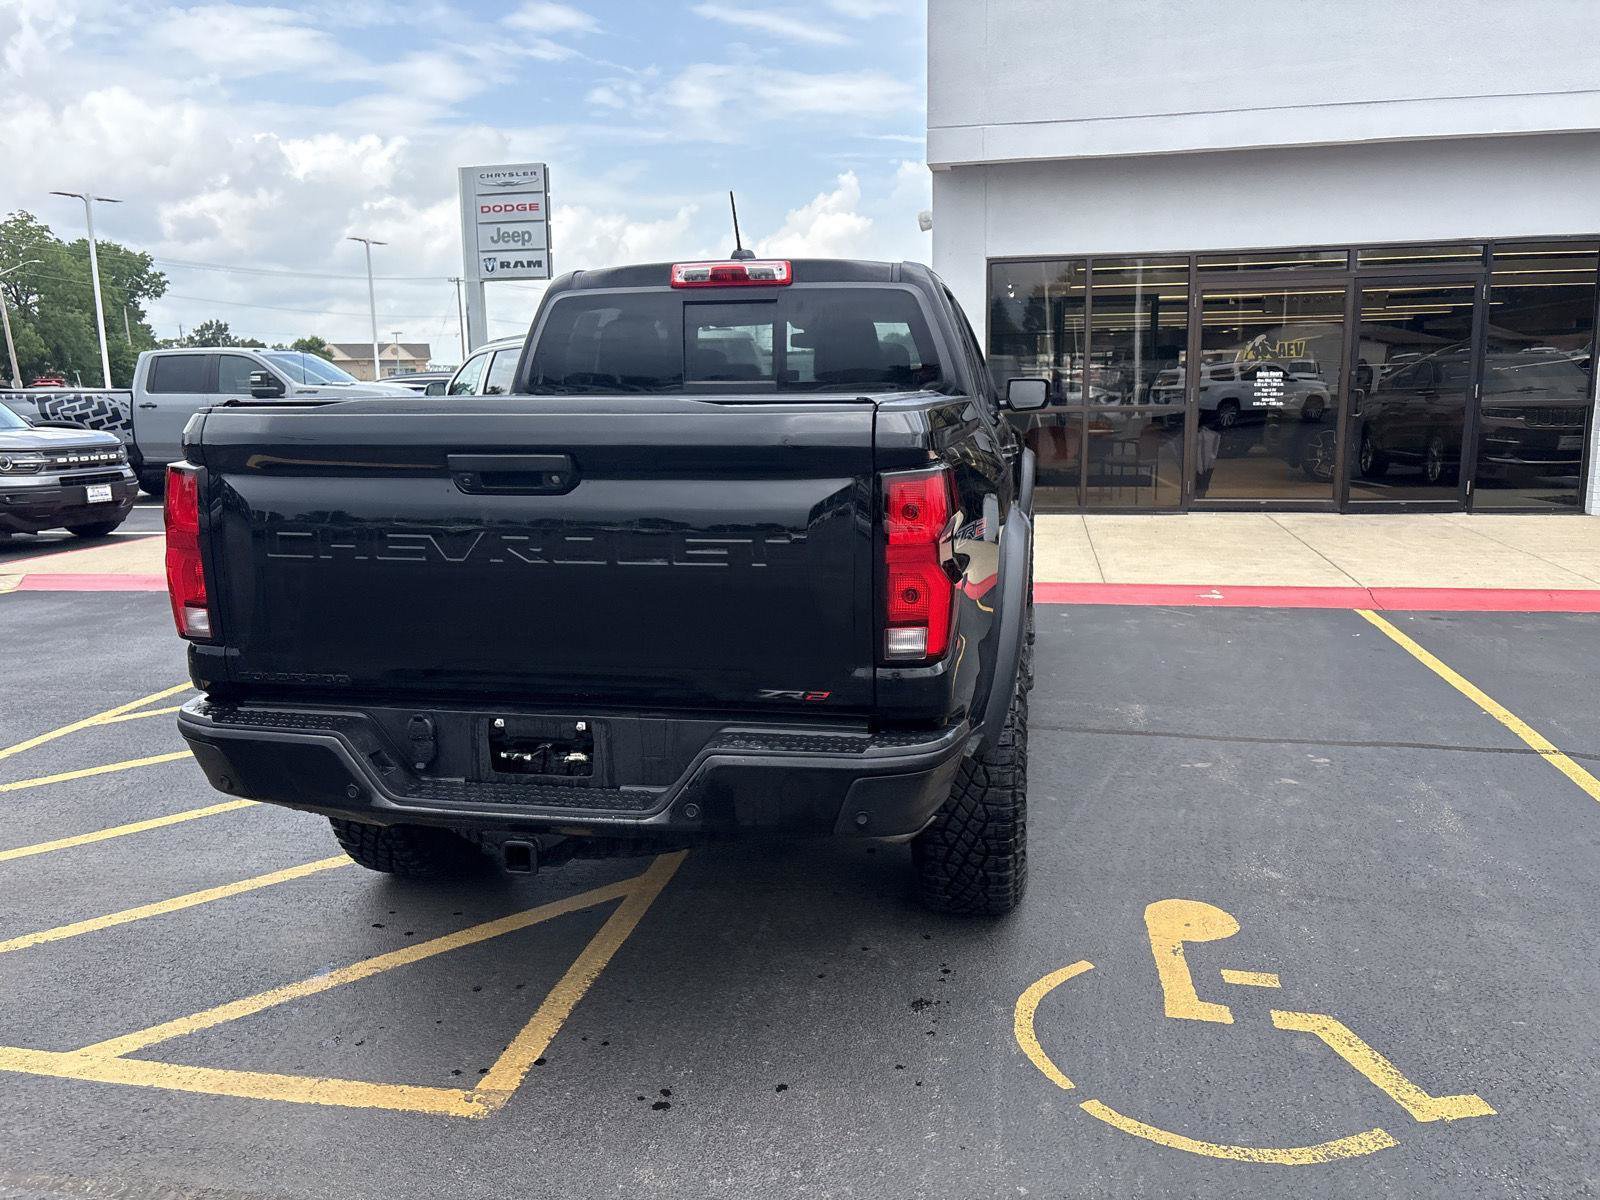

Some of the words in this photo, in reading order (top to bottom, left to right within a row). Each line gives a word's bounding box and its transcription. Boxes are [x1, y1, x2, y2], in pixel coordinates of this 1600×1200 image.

[479, 171, 537, 179] CHRYSLER
[480, 203, 540, 214] DODGE
[490, 227, 532, 246] Jeep
[499, 260, 543, 269] RAM
[1277, 342, 1304, 357] AEV
[56, 453, 116, 462] BRONCO
[267, 531, 792, 567] CHEVROLET
[757, 688, 833, 701] ZR2
